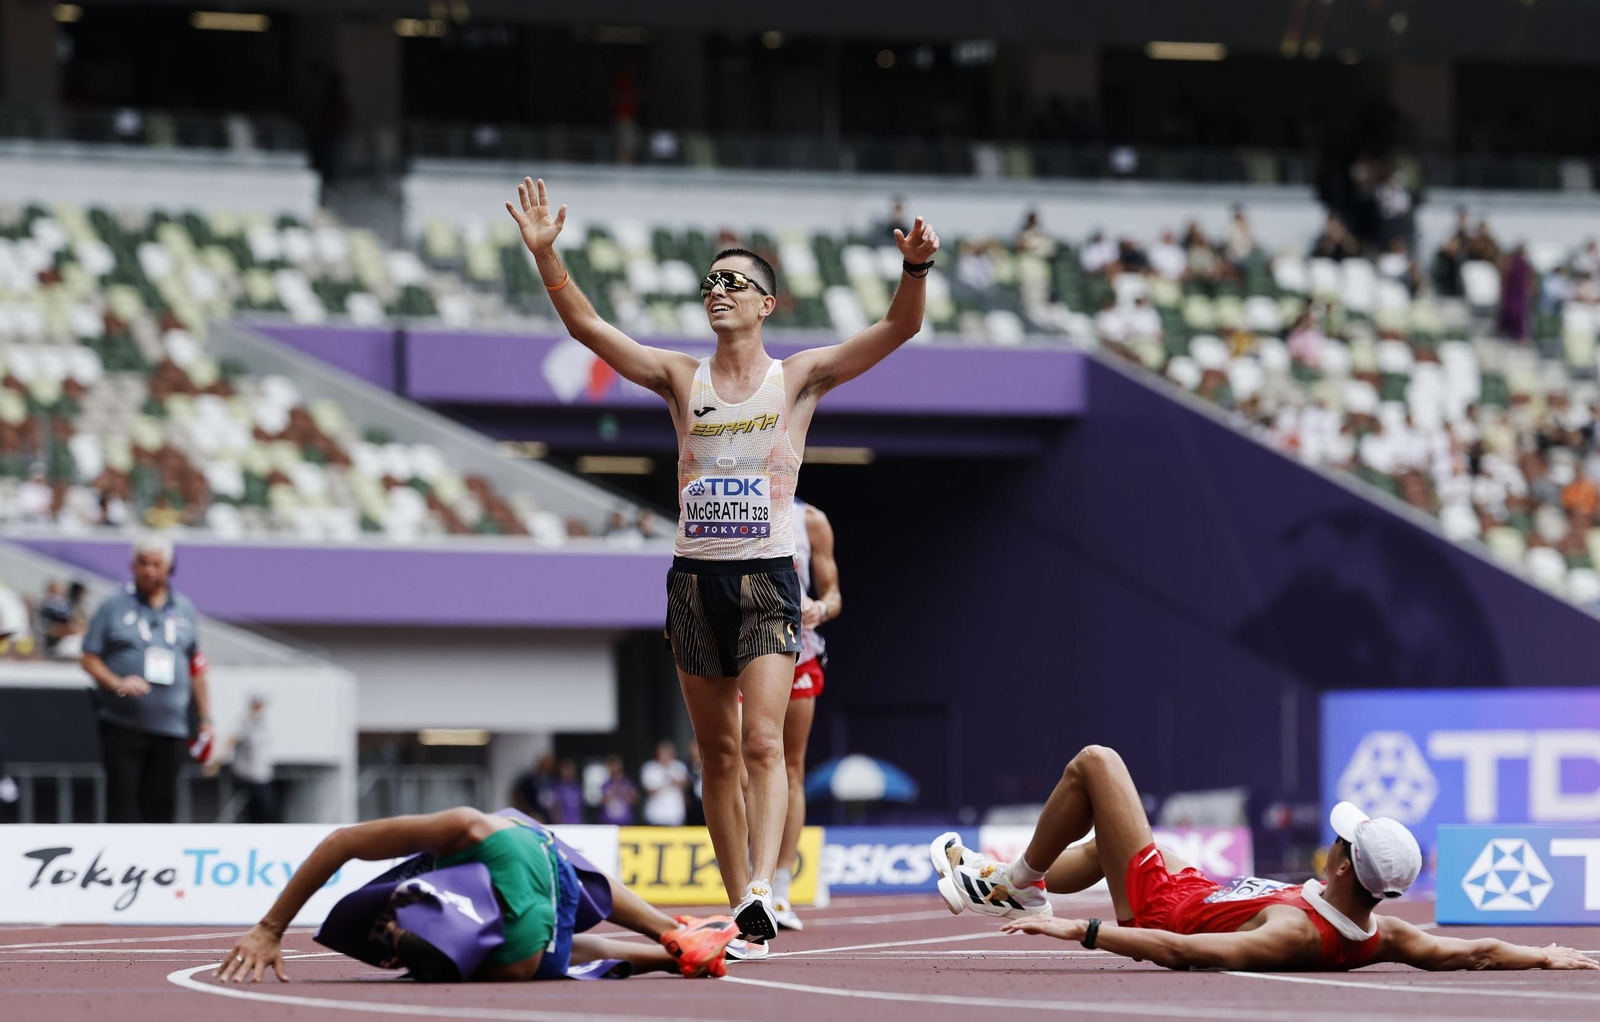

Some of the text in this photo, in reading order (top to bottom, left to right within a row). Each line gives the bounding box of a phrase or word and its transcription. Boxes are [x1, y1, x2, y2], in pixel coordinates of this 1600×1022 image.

[705, 478, 764, 496] TDK
[686, 502, 769, 521] McGRATH 328
[24, 846, 179, 912] Tokyo
